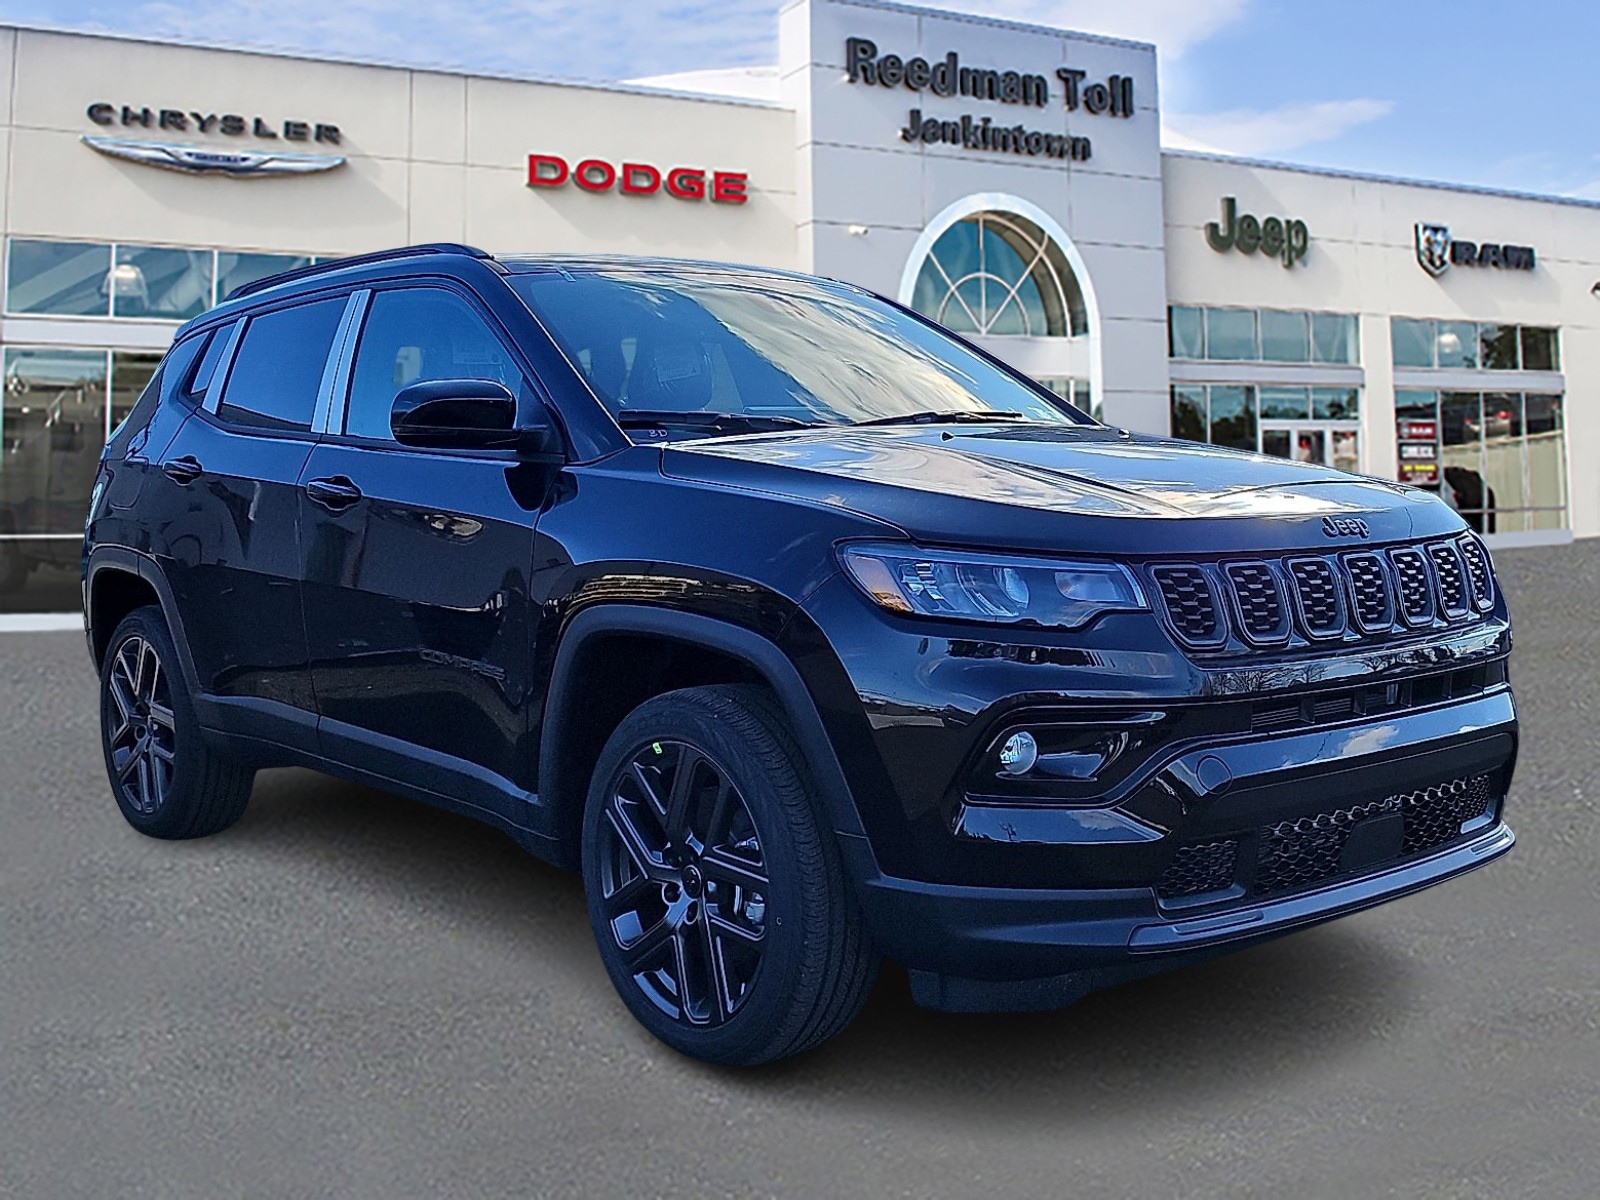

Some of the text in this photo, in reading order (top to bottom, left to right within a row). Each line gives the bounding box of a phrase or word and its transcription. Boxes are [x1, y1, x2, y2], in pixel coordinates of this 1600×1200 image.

[846, 37, 1134, 118] Reedman Toll
[86, 102, 342, 145] CHRYSLER
[901, 108, 1092, 161] Jenkintown
[528, 153, 748, 204] DODGE
[1205, 197, 1308, 269] Jeep
[1450, 239, 1536, 271] RAM
[1321, 516, 1370, 539] Jeep
